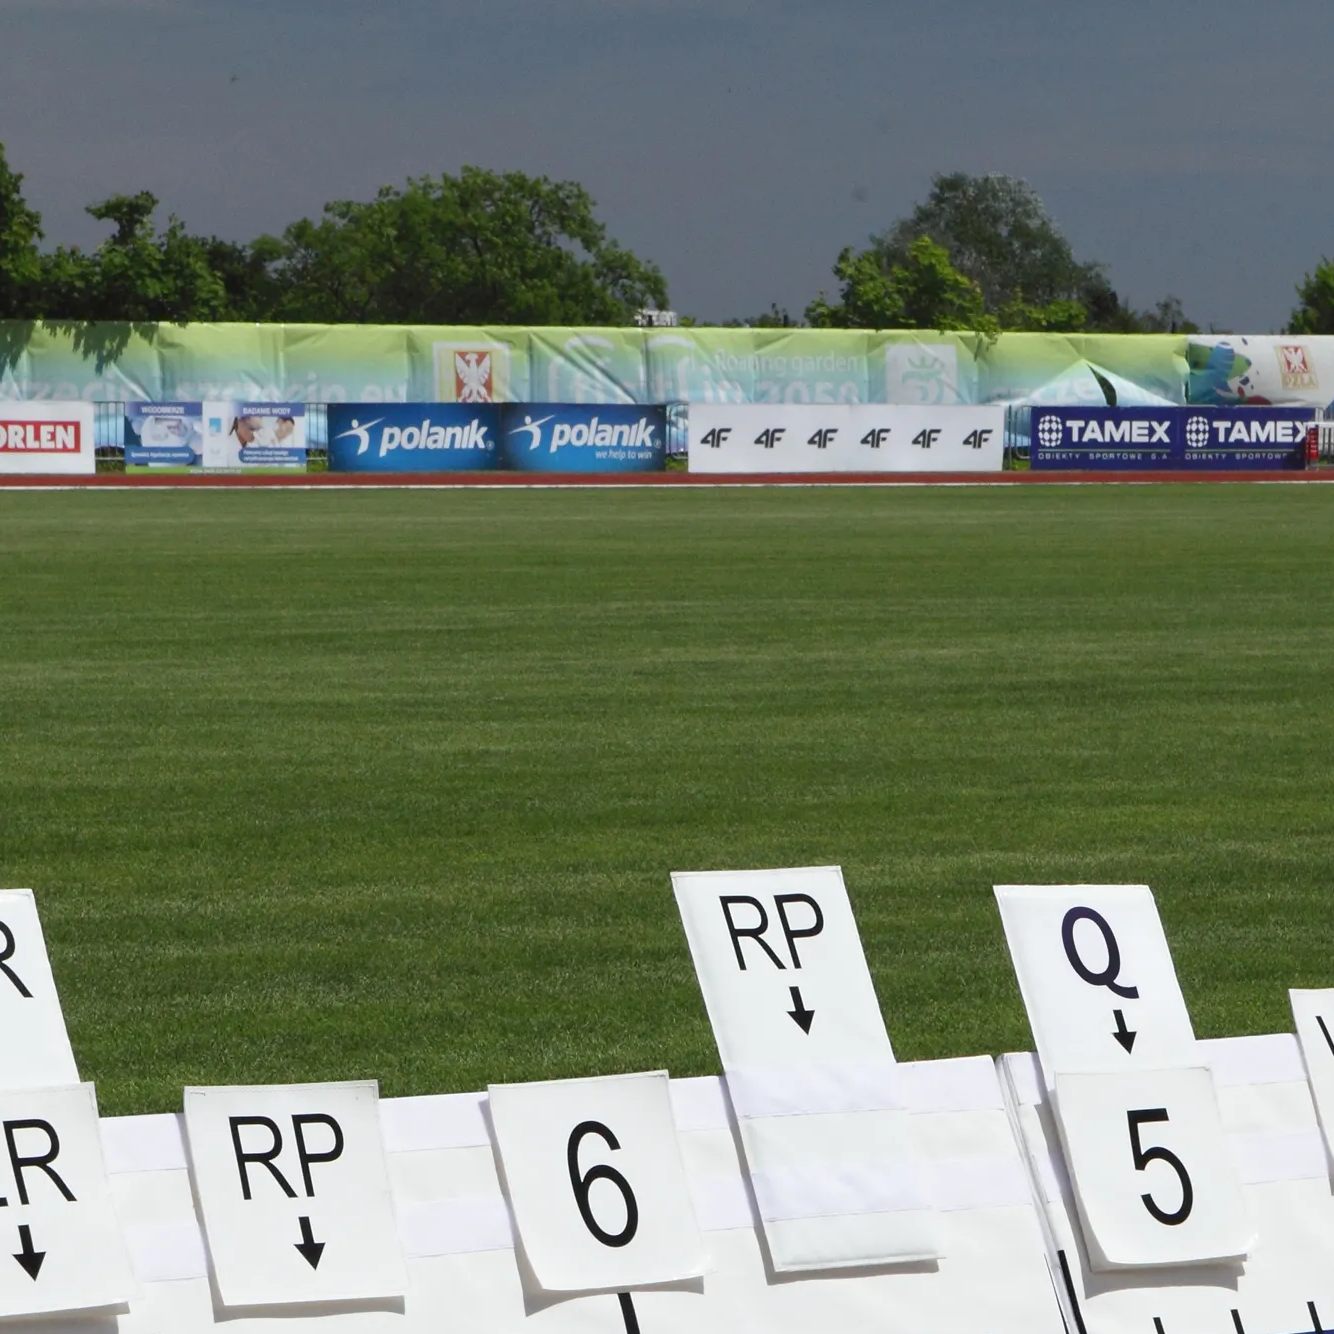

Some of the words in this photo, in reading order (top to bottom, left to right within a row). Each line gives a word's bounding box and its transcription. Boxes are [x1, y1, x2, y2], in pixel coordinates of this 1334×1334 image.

[791, 351, 860, 376] garden
[379, 418, 489, 458] polanik
[550, 416, 656, 453] polanik
[700, 427, 732, 449] 4F
[754, 428, 786, 449] 4F
[807, 428, 838, 449] 4F
[860, 428, 891, 449] 4F
[912, 429, 942, 449] 4F
[962, 429, 993, 449] 4F
[1066, 420, 1171, 443] TAMEX
[1212, 420, 1307, 443] TAMEX
[595, 451, 607, 459] we
[607, 450, 626, 461] help
[627, 451, 637, 459] to
[637, 451, 652, 459] win
[1038, 452, 1080, 460] OBIEKTY
[718, 893, 825, 971] RP
[1060, 906, 1140, 999] Q
[228, 1113, 345, 1201] RP
[1126, 1107, 1194, 1226] 5
[566, 1120, 639, 1248] 6
